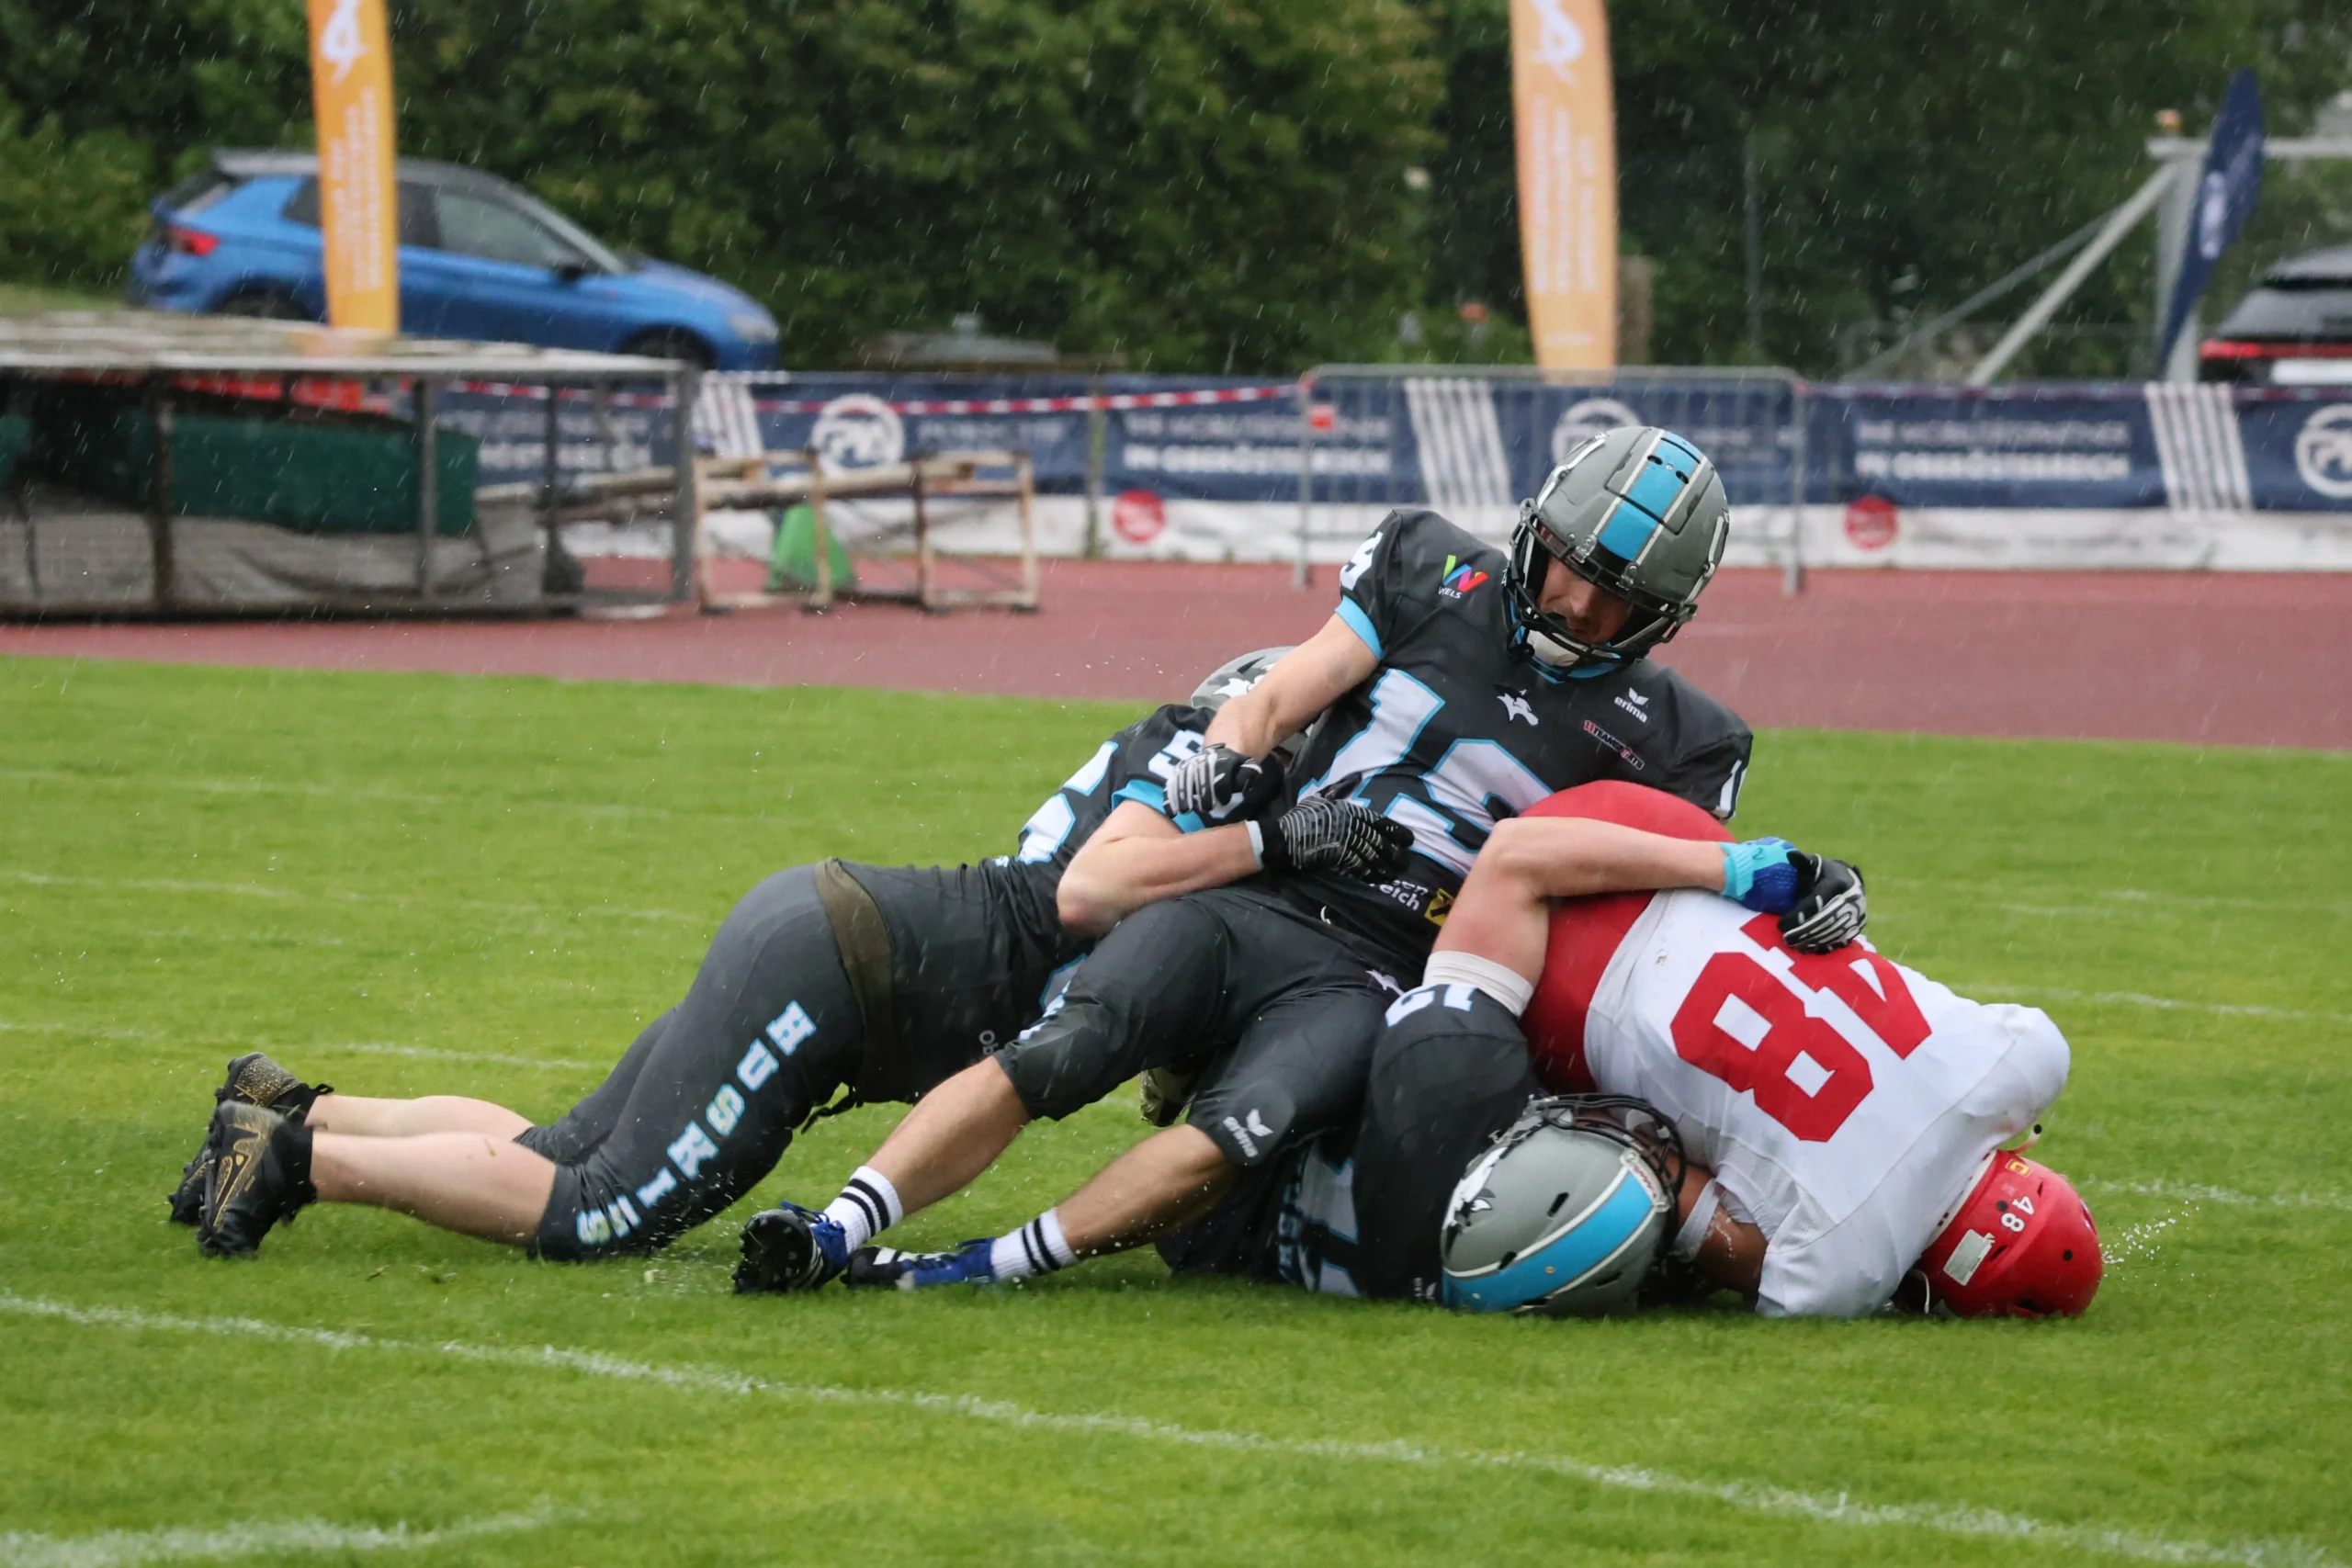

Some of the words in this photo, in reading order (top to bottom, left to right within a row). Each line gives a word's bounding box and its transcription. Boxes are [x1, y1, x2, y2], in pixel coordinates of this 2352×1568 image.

[1438, 586, 1463, 599] WELS
[1613, 695, 1648, 724] erima
[1669, 912, 1933, 1143] 48
[2000, 1195, 2035, 1233] 48
